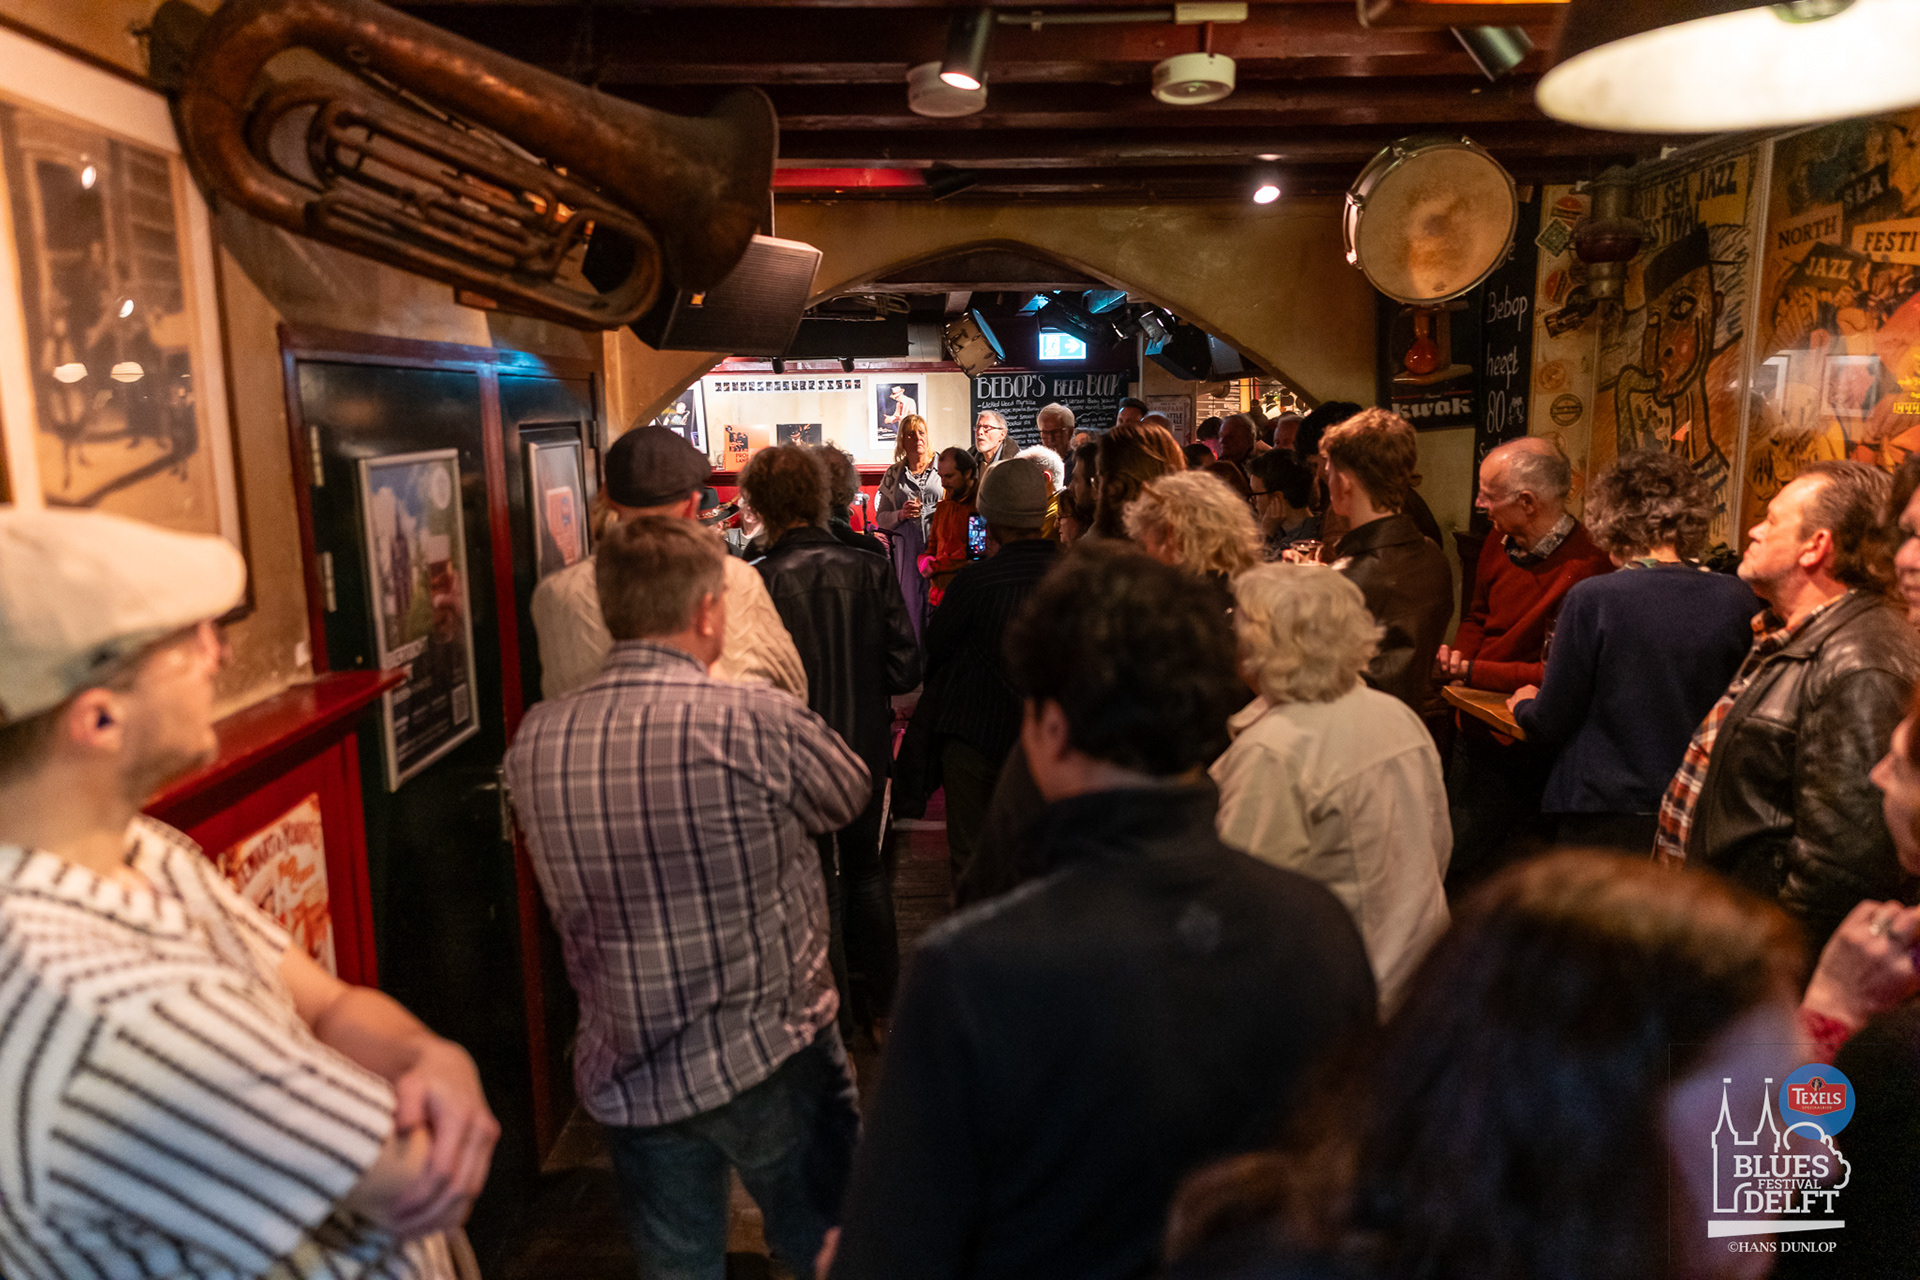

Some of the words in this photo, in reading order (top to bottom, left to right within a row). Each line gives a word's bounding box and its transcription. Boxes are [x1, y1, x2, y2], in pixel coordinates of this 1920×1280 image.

[1695, 161, 1738, 202] JAZZ
[1844, 174, 1884, 206] SEA
[1778, 215, 1837, 249] NORTH
[1805, 257, 1852, 281] JAZZ
[1486, 285, 1528, 331] Bebop
[1486, 342, 1519, 389] heeft
[1053, 379, 1084, 397] BEER
[1486, 390, 1505, 433] 80
